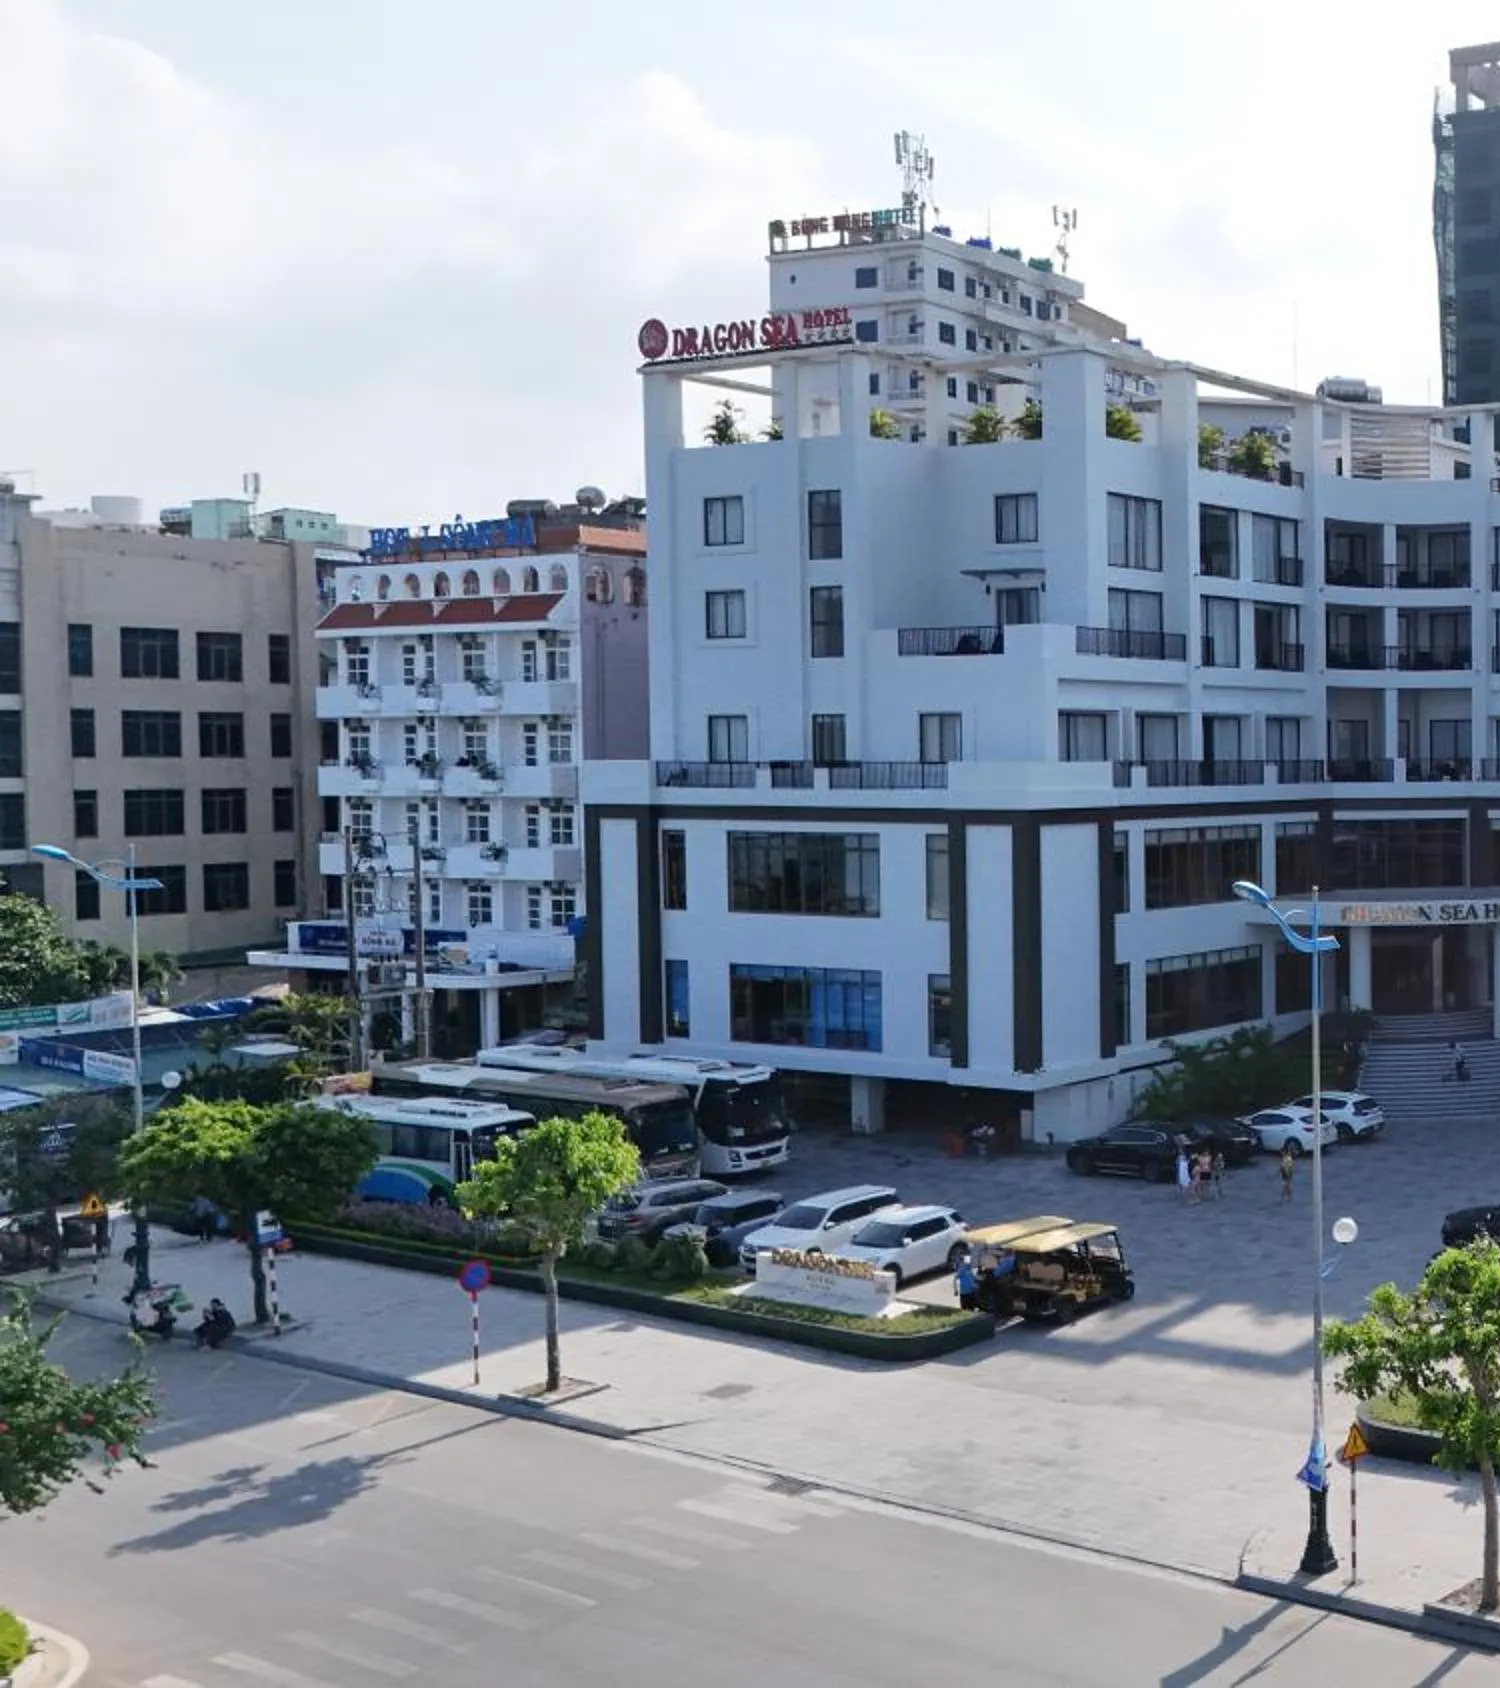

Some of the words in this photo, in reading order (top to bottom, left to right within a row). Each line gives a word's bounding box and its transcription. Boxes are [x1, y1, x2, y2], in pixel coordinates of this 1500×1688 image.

[672, 318, 757, 357] DRAGON
[760, 312, 800, 348] SEA
[803, 307, 851, 329] HOTEL
[1439, 903, 1480, 922] SEA
